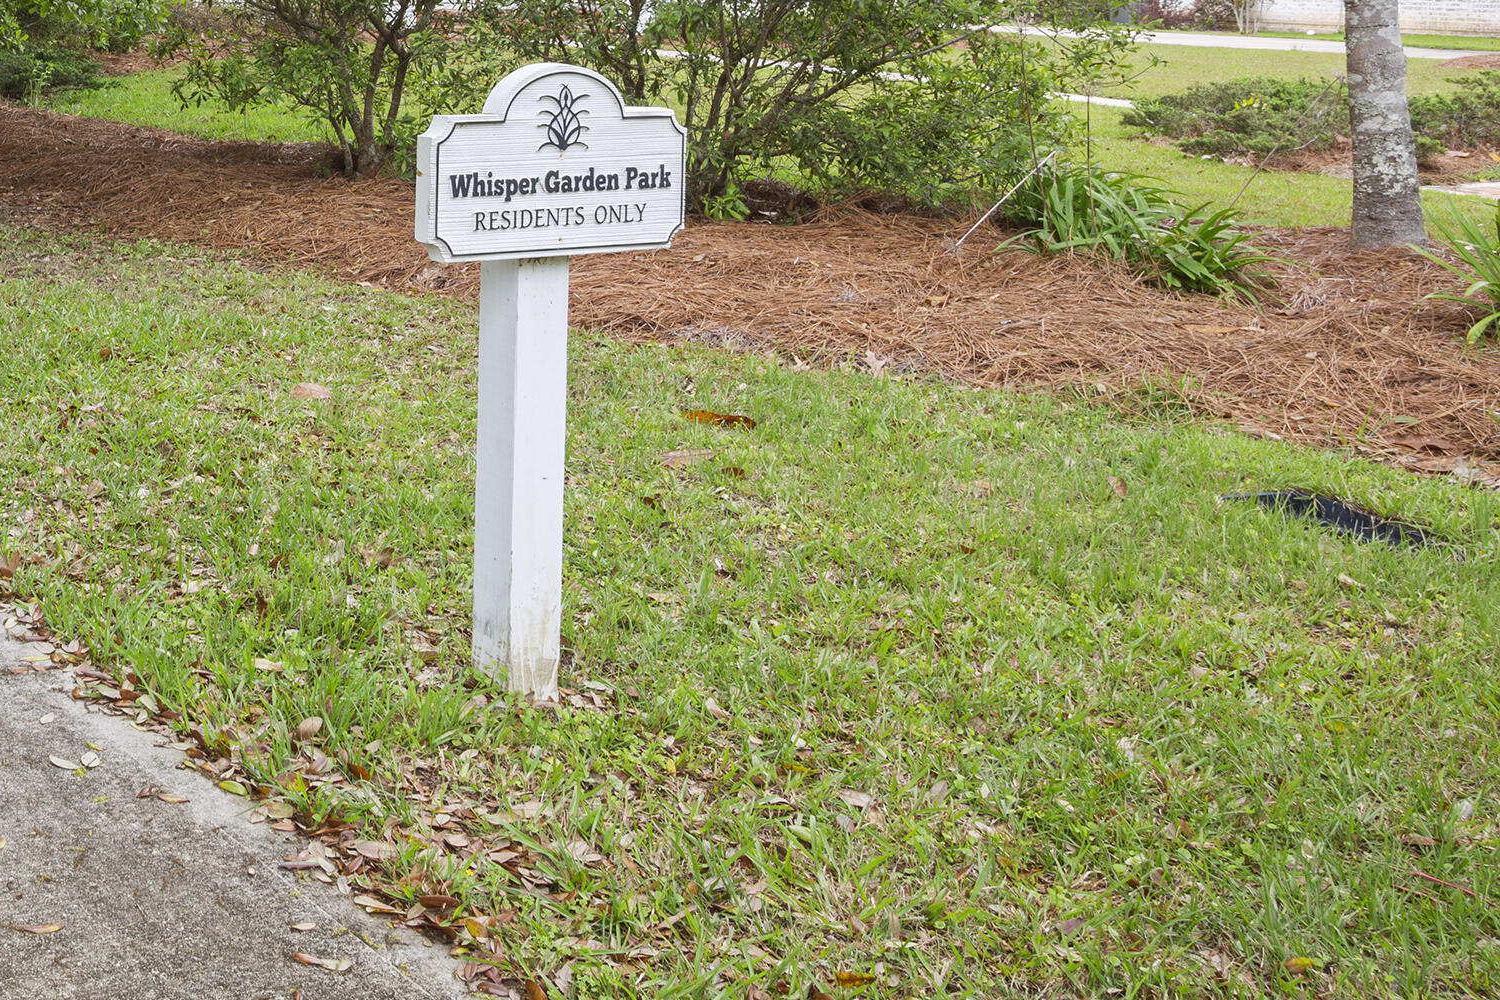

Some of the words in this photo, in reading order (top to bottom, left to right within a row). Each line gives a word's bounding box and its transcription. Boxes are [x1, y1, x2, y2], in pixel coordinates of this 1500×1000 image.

[450, 172, 539, 201] Whisper
[544, 167, 619, 193] Garden
[625, 164, 672, 190] Park
[474, 206, 585, 231] RESIDENTS
[594, 203, 647, 224] ONLY
